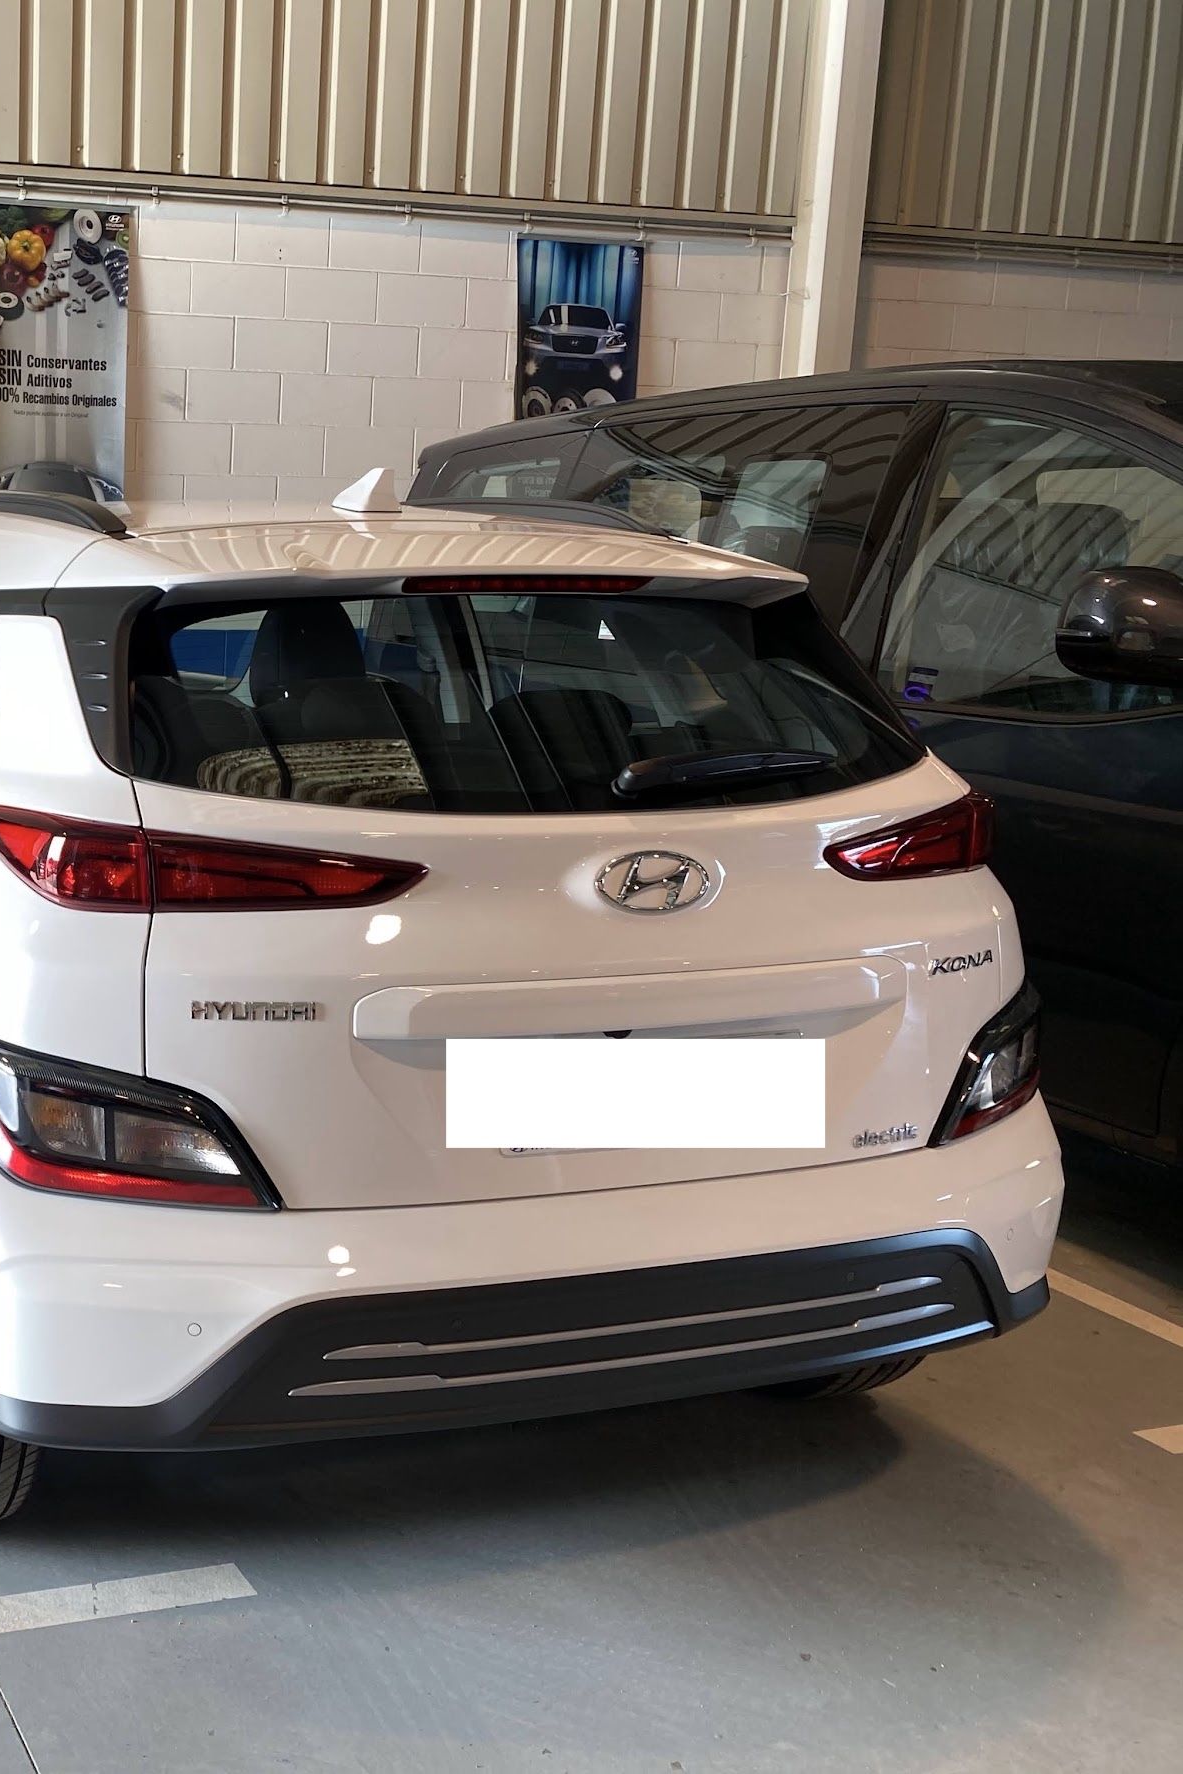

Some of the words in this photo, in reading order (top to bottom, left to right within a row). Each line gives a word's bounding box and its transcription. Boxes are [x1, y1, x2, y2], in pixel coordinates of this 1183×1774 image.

[26, 354, 107, 371] Conservantes
[26, 373, 73, 388] Aditivos
[22, 391, 70, 406] Recambios
[72, 394, 117, 408] Originales
[929, 949, 993, 975] KONA
[191, 1001, 316, 1021] HYUNDAI
